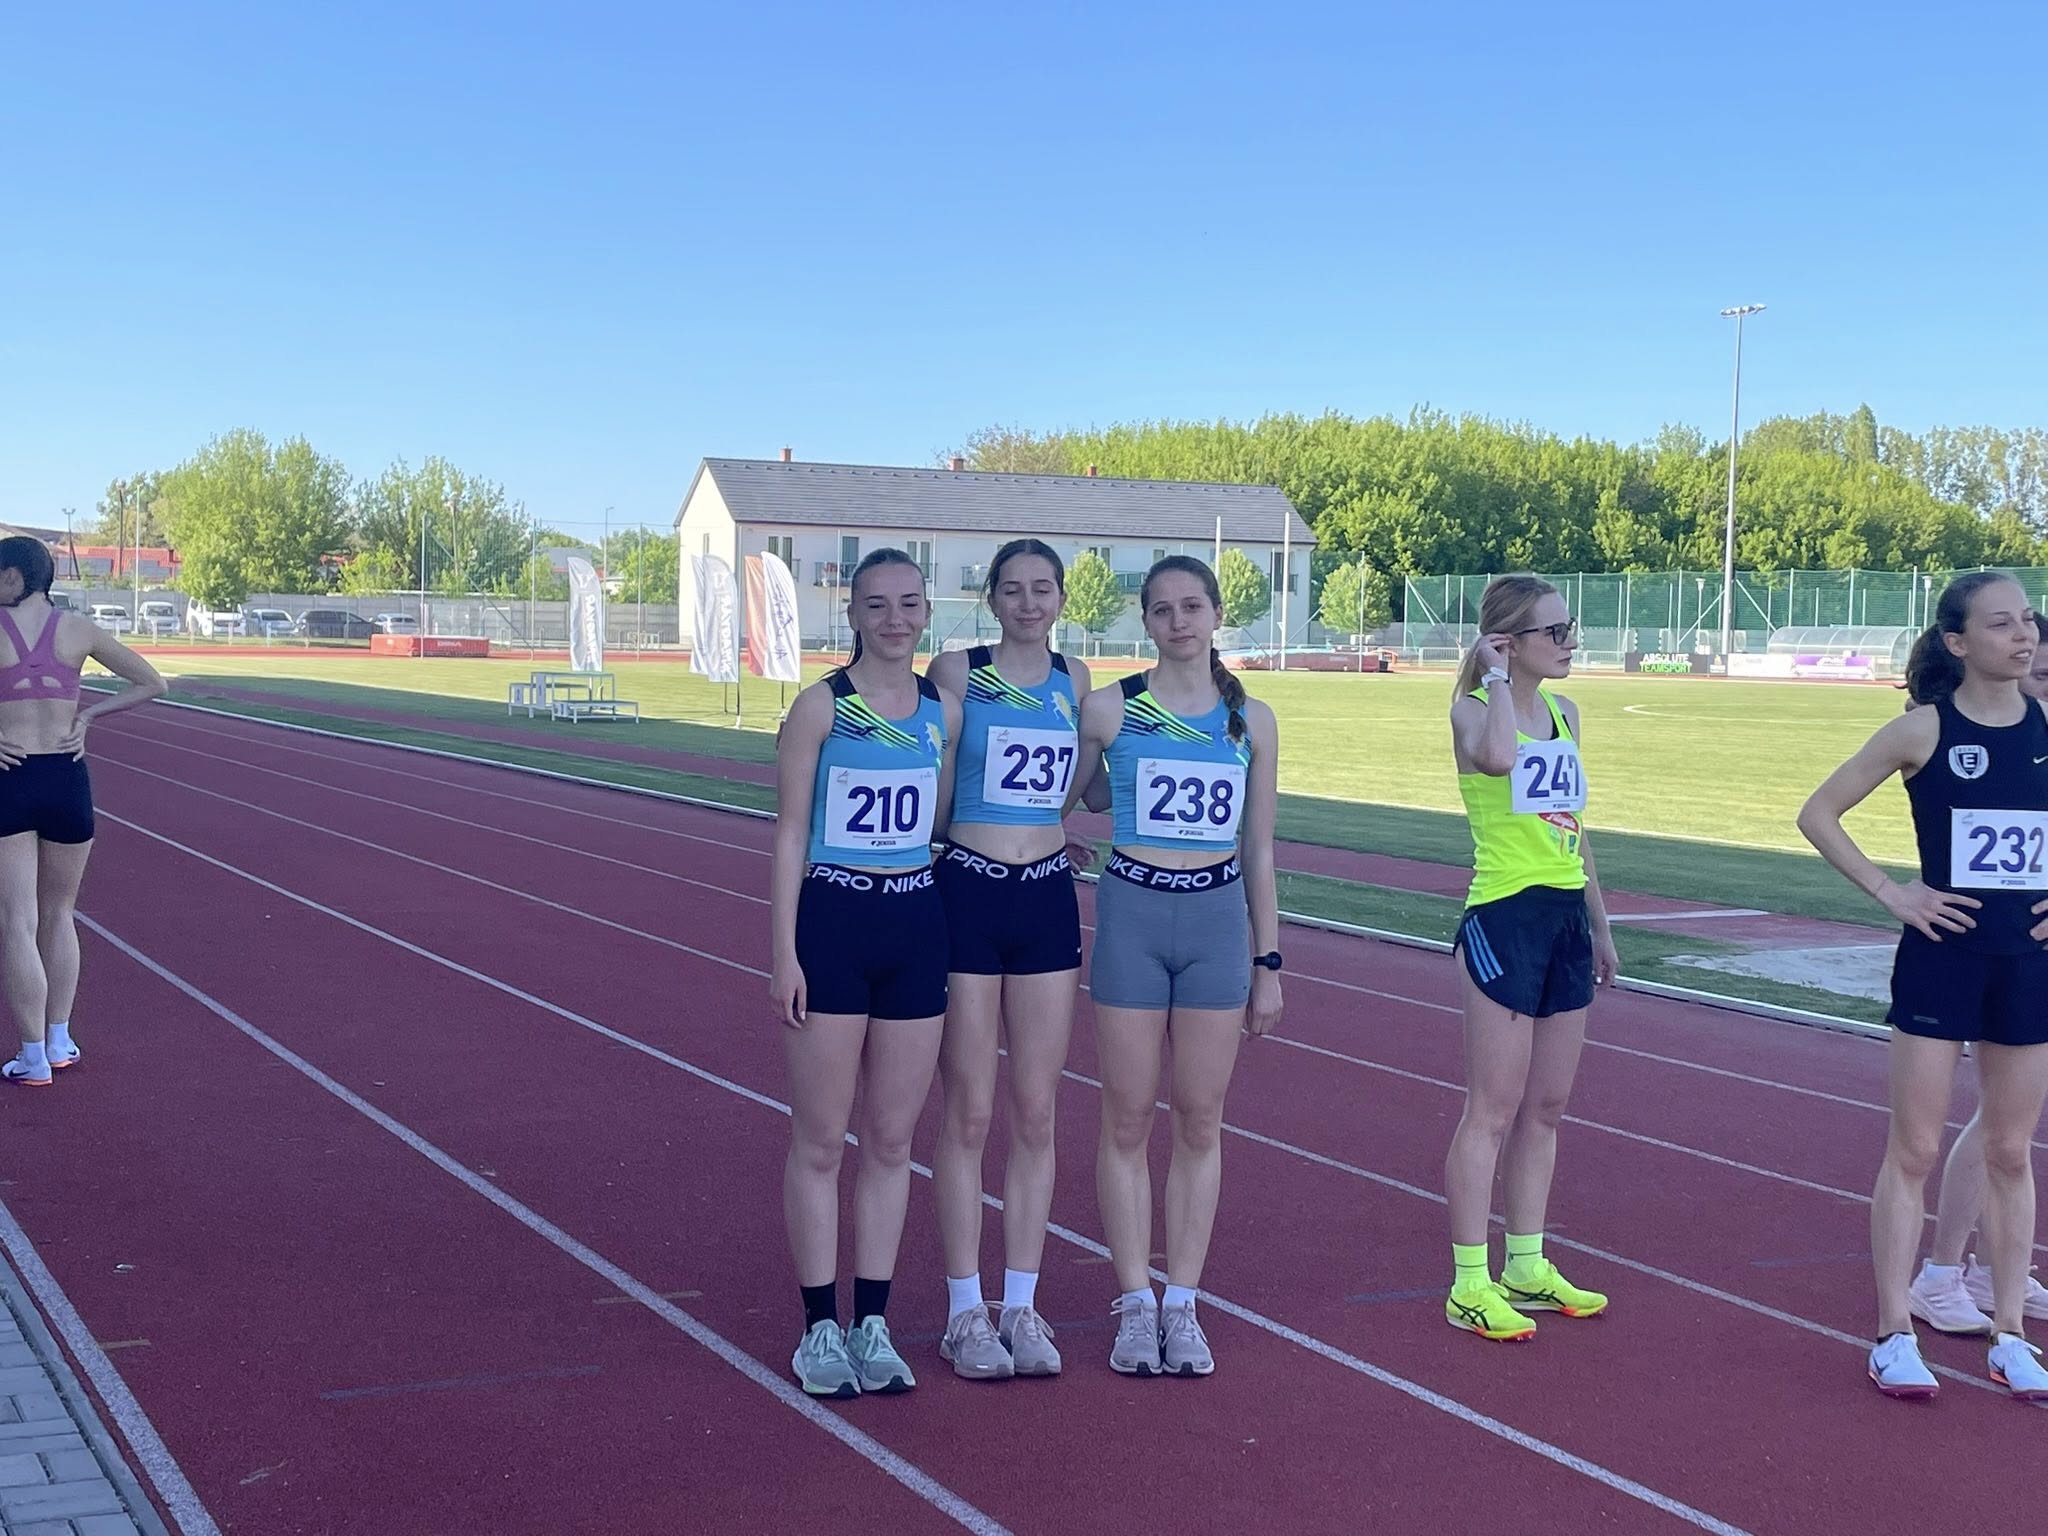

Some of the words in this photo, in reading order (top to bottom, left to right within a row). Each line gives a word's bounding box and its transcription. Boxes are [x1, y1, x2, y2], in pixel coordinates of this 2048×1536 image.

[1639, 662, 1693, 673] TEAMSPORT
[1642, 653, 1690, 663] ABSOLUTE
[1000, 744, 1073, 793] 237
[1962, 753, 1976, 769] E
[846, 785, 919, 833] 210
[1149, 775, 1233, 825] 238
[946, 848, 1009, 879] PRO
[1020, 852, 1070, 881] NIKE
[1968, 826, 2045, 873] 232
[812, 865, 873, 891] PRO
[882, 869, 934, 893] NIKE
[1150, 872, 1212, 888] PRO
